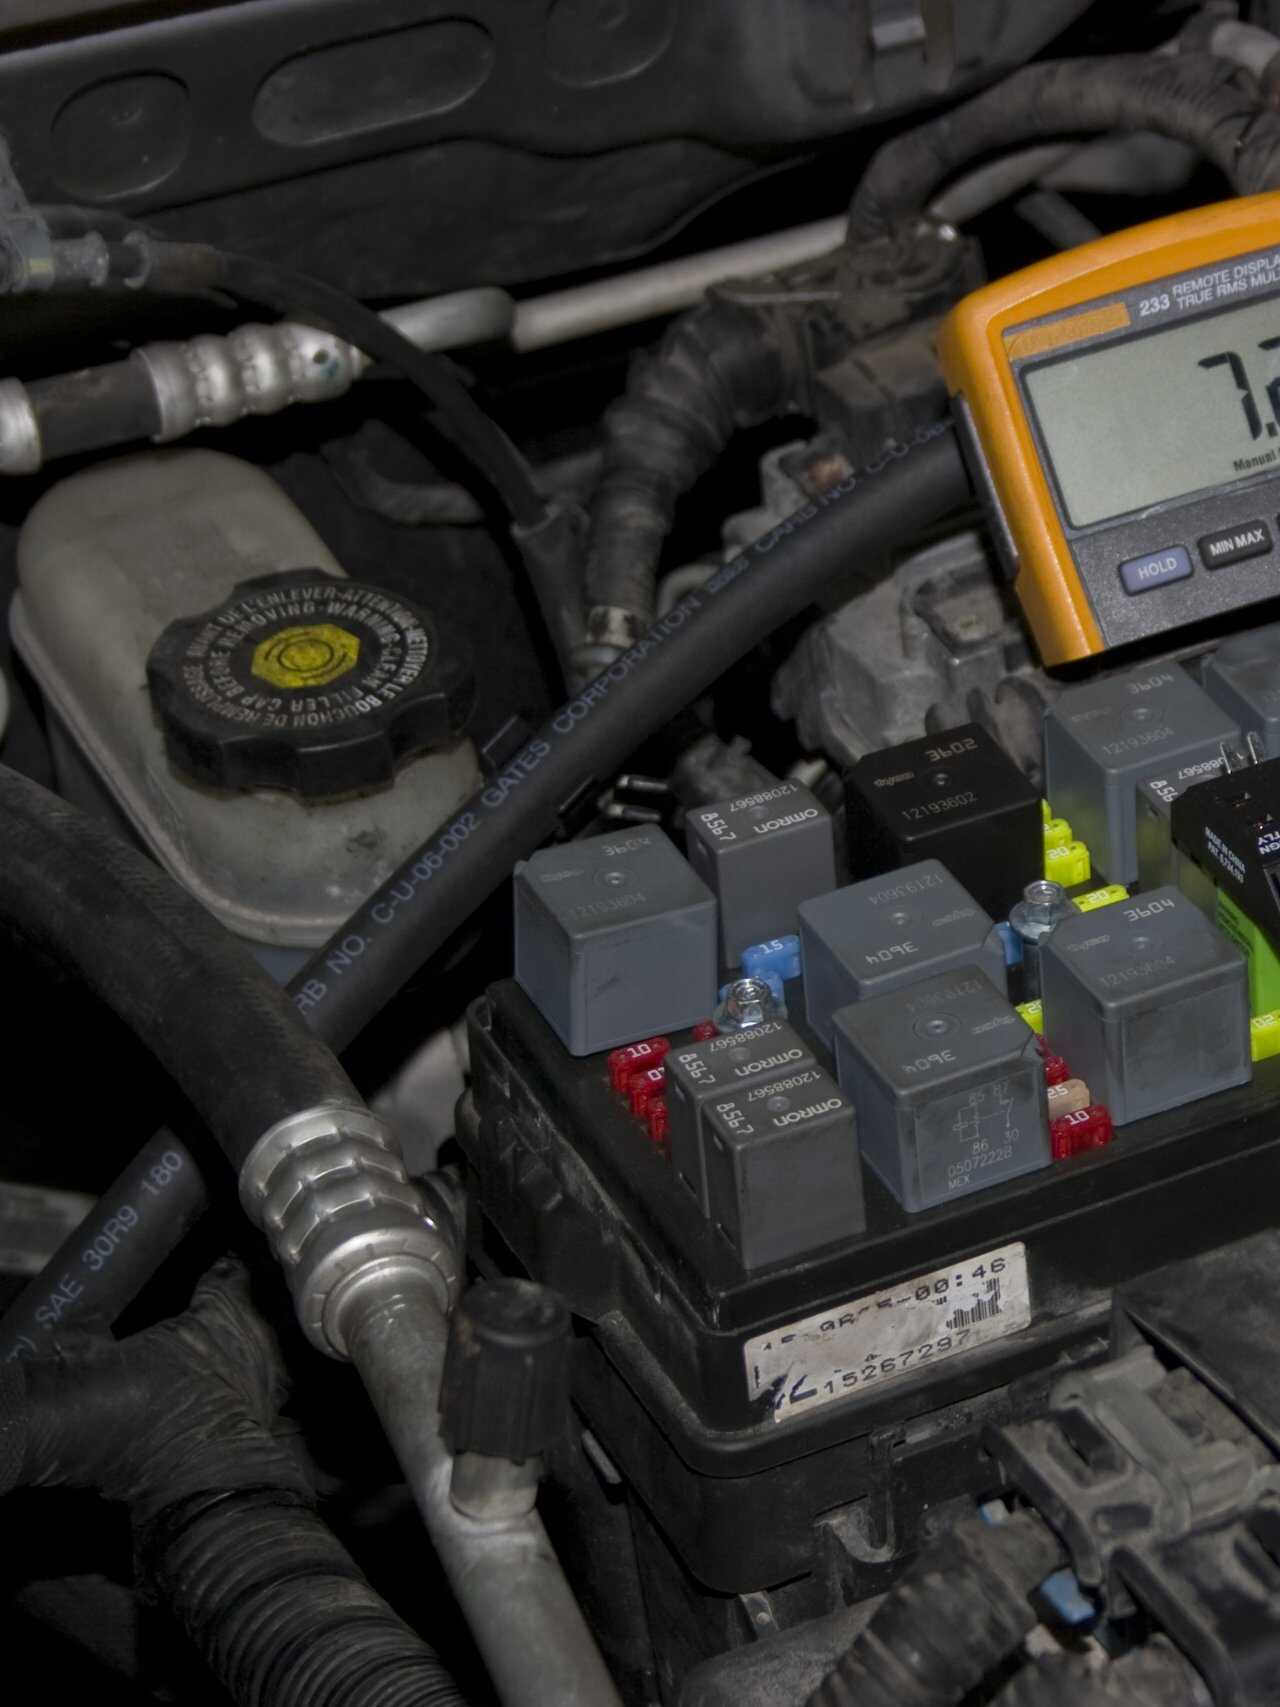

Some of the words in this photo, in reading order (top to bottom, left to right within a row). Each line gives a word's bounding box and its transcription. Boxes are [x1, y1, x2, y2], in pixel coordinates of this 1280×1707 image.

[1139, 294, 1170, 316] 233
[1172, 270, 1231, 297] REMOTE
[1177, 290, 1214, 310] TRUE
[1216, 279, 1248, 298] RMS
[1233, 450, 1276, 472] Manual
[1209, 540, 1235, 557] MIN
[1234, 529, 1265, 549] MAX
[1138, 558, 1177, 581] HOLD
[241, 694, 281, 712] CAP
[291, 686, 364, 713] FILLER
[293, 694, 382, 726] BOUCHON
[263, 711, 288, 726] DE
[325, 934, 374, 974] NO.
[371, 811, 477, 924] C-U-06-002
[481, 741, 551, 808] GATES
[552, 594, 702, 734] CORPORATION
[729, 783, 799, 812] 12088567
[902, 791, 978, 820] 12193602
[760, 939, 784, 954] 15
[627, 1043, 652, 1058] 10
[709, 1021, 785, 1052] 12088567
[747, 1070, 822, 1103] 12088567
[1047, 1083, 1069, 1099] 25
[1065, 1110, 1090, 1126] 10
[34, 1273, 84, 1330] SAE
[82, 1204, 139, 1271] 30R9
[141, 1151, 183, 1196] 180
